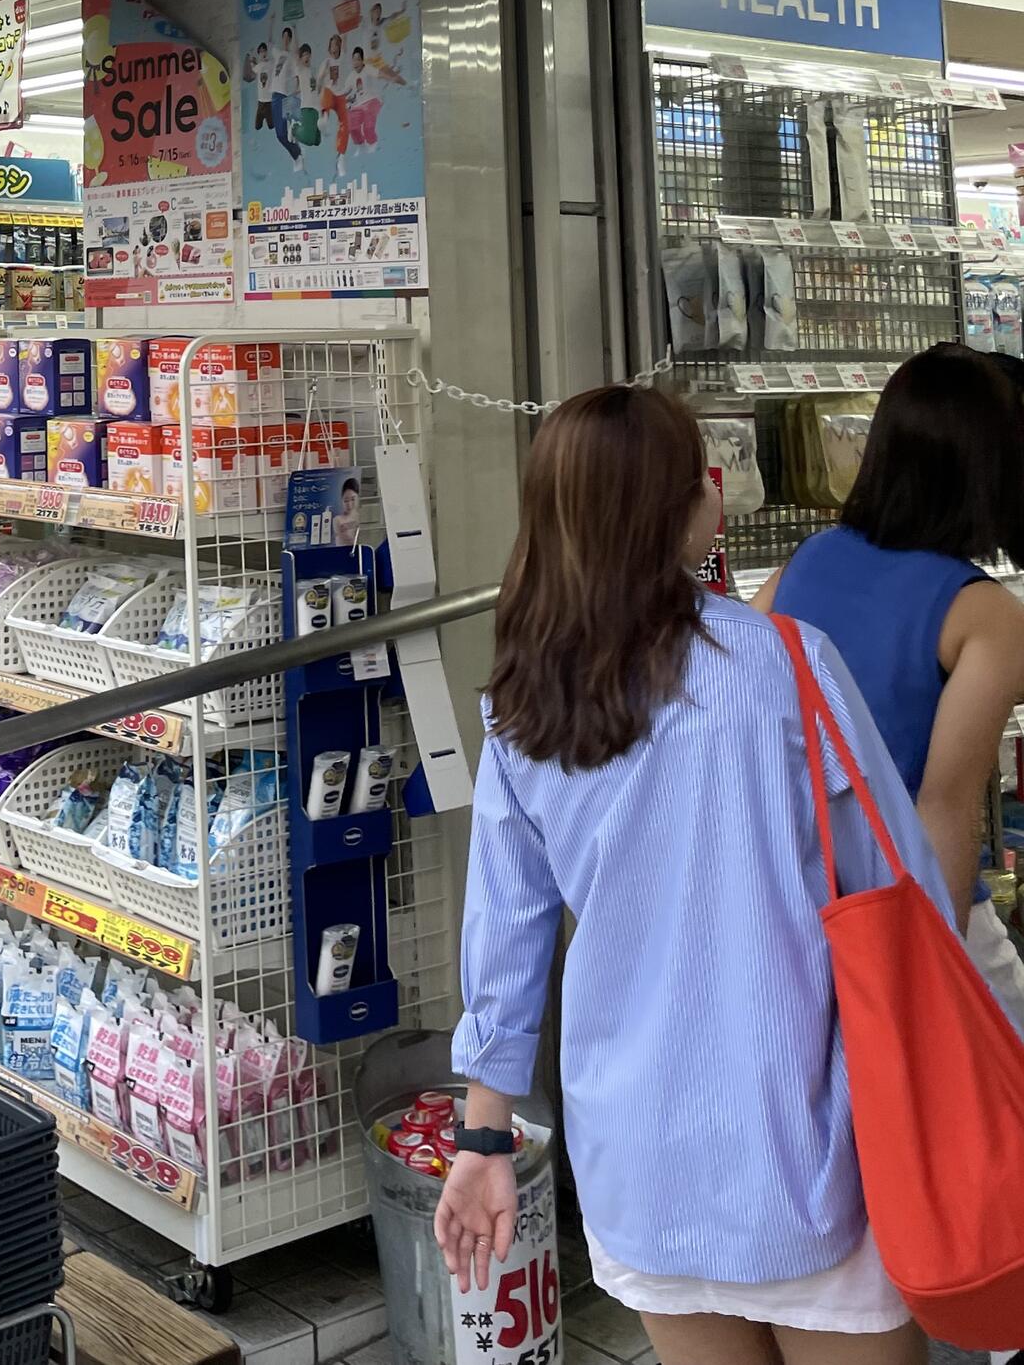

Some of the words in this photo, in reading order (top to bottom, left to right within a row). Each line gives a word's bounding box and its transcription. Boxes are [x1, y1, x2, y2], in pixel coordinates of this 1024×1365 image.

[110, 85, 199, 143] Sale
[139, 501, 172, 525] 1410
[138, 523, 168, 535] 1551
[109, 712, 168, 738] 80
[9, 875, 37, 897] Sale
[126, 929, 184, 965] 298
[110, 1134, 182, 1189] 298
[495, 1249, 559, 1348] 516
[460, 1312, 494, 1328] 本体
